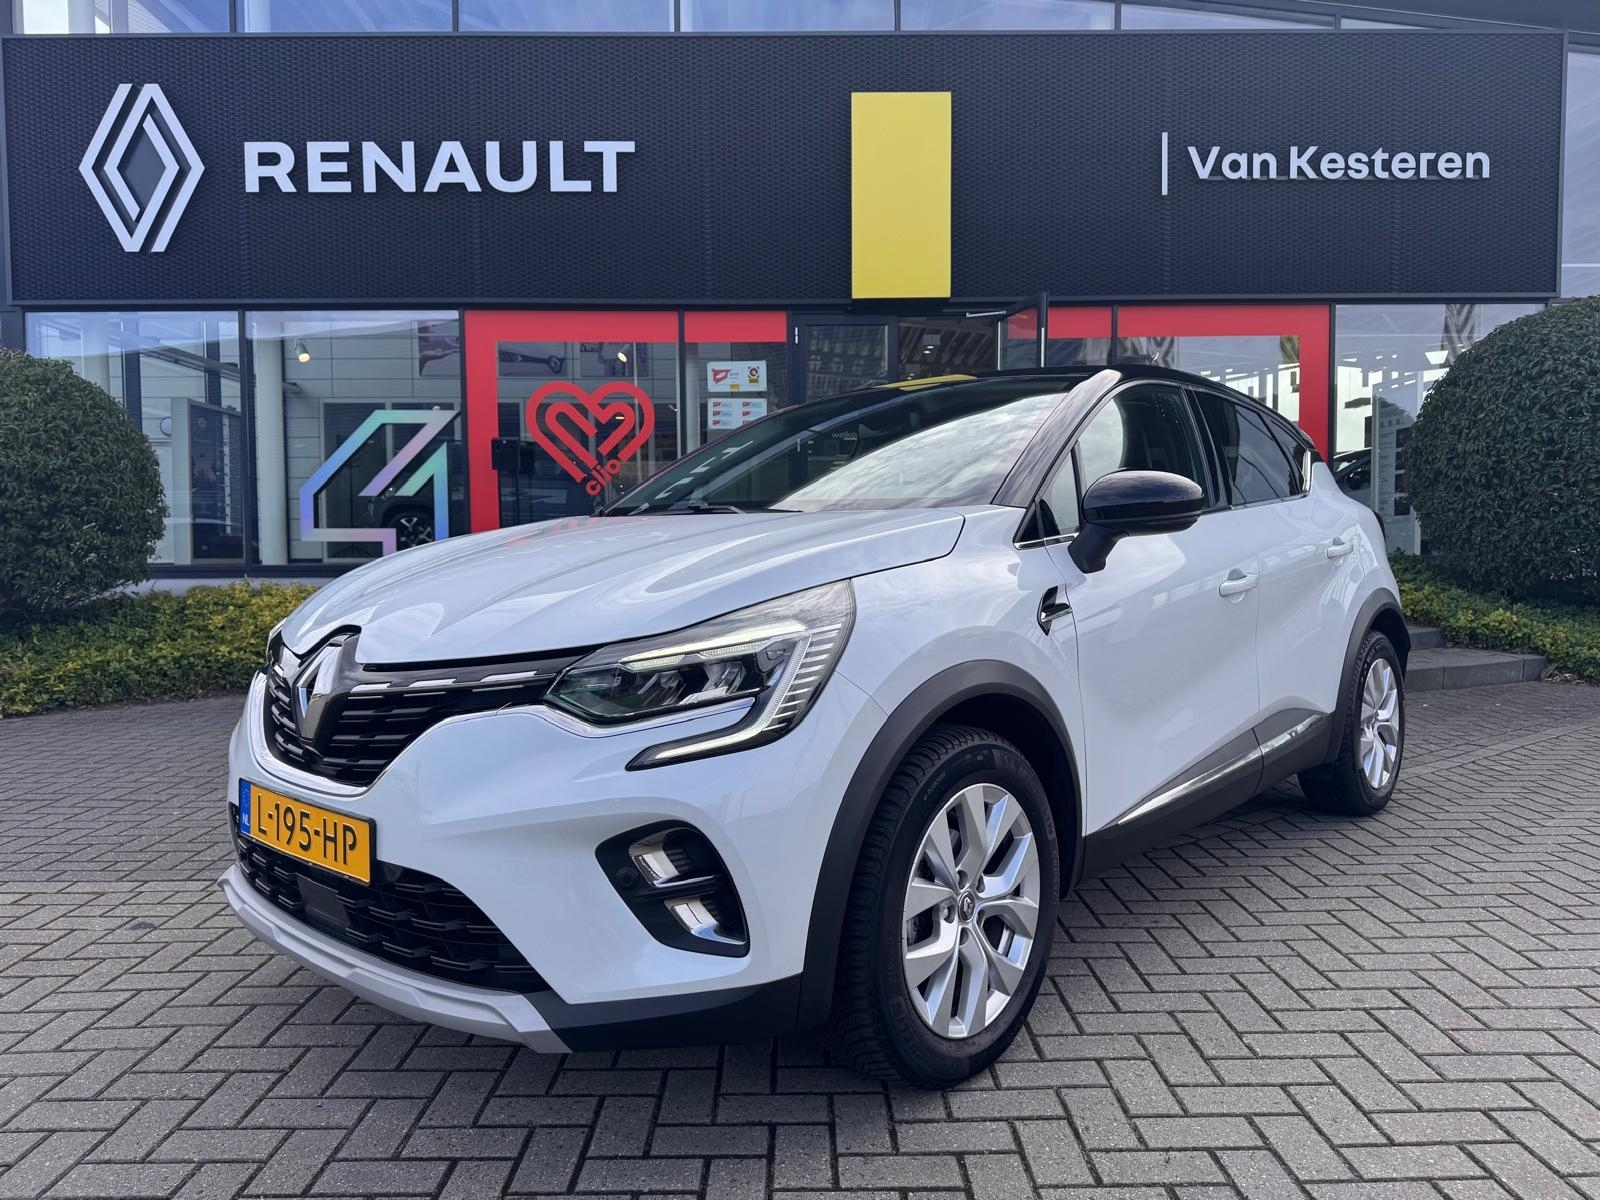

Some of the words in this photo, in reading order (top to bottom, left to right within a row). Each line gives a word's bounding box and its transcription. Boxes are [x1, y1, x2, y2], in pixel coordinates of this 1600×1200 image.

[243, 140, 636, 194] RENAULT
[1187, 146, 1278, 180] Van
[1289, 145, 1490, 180] Kesteren
[585, 458, 622, 496] clio
[242, 812, 250, 826] NL
[257, 794, 357, 865] L-195-HP
